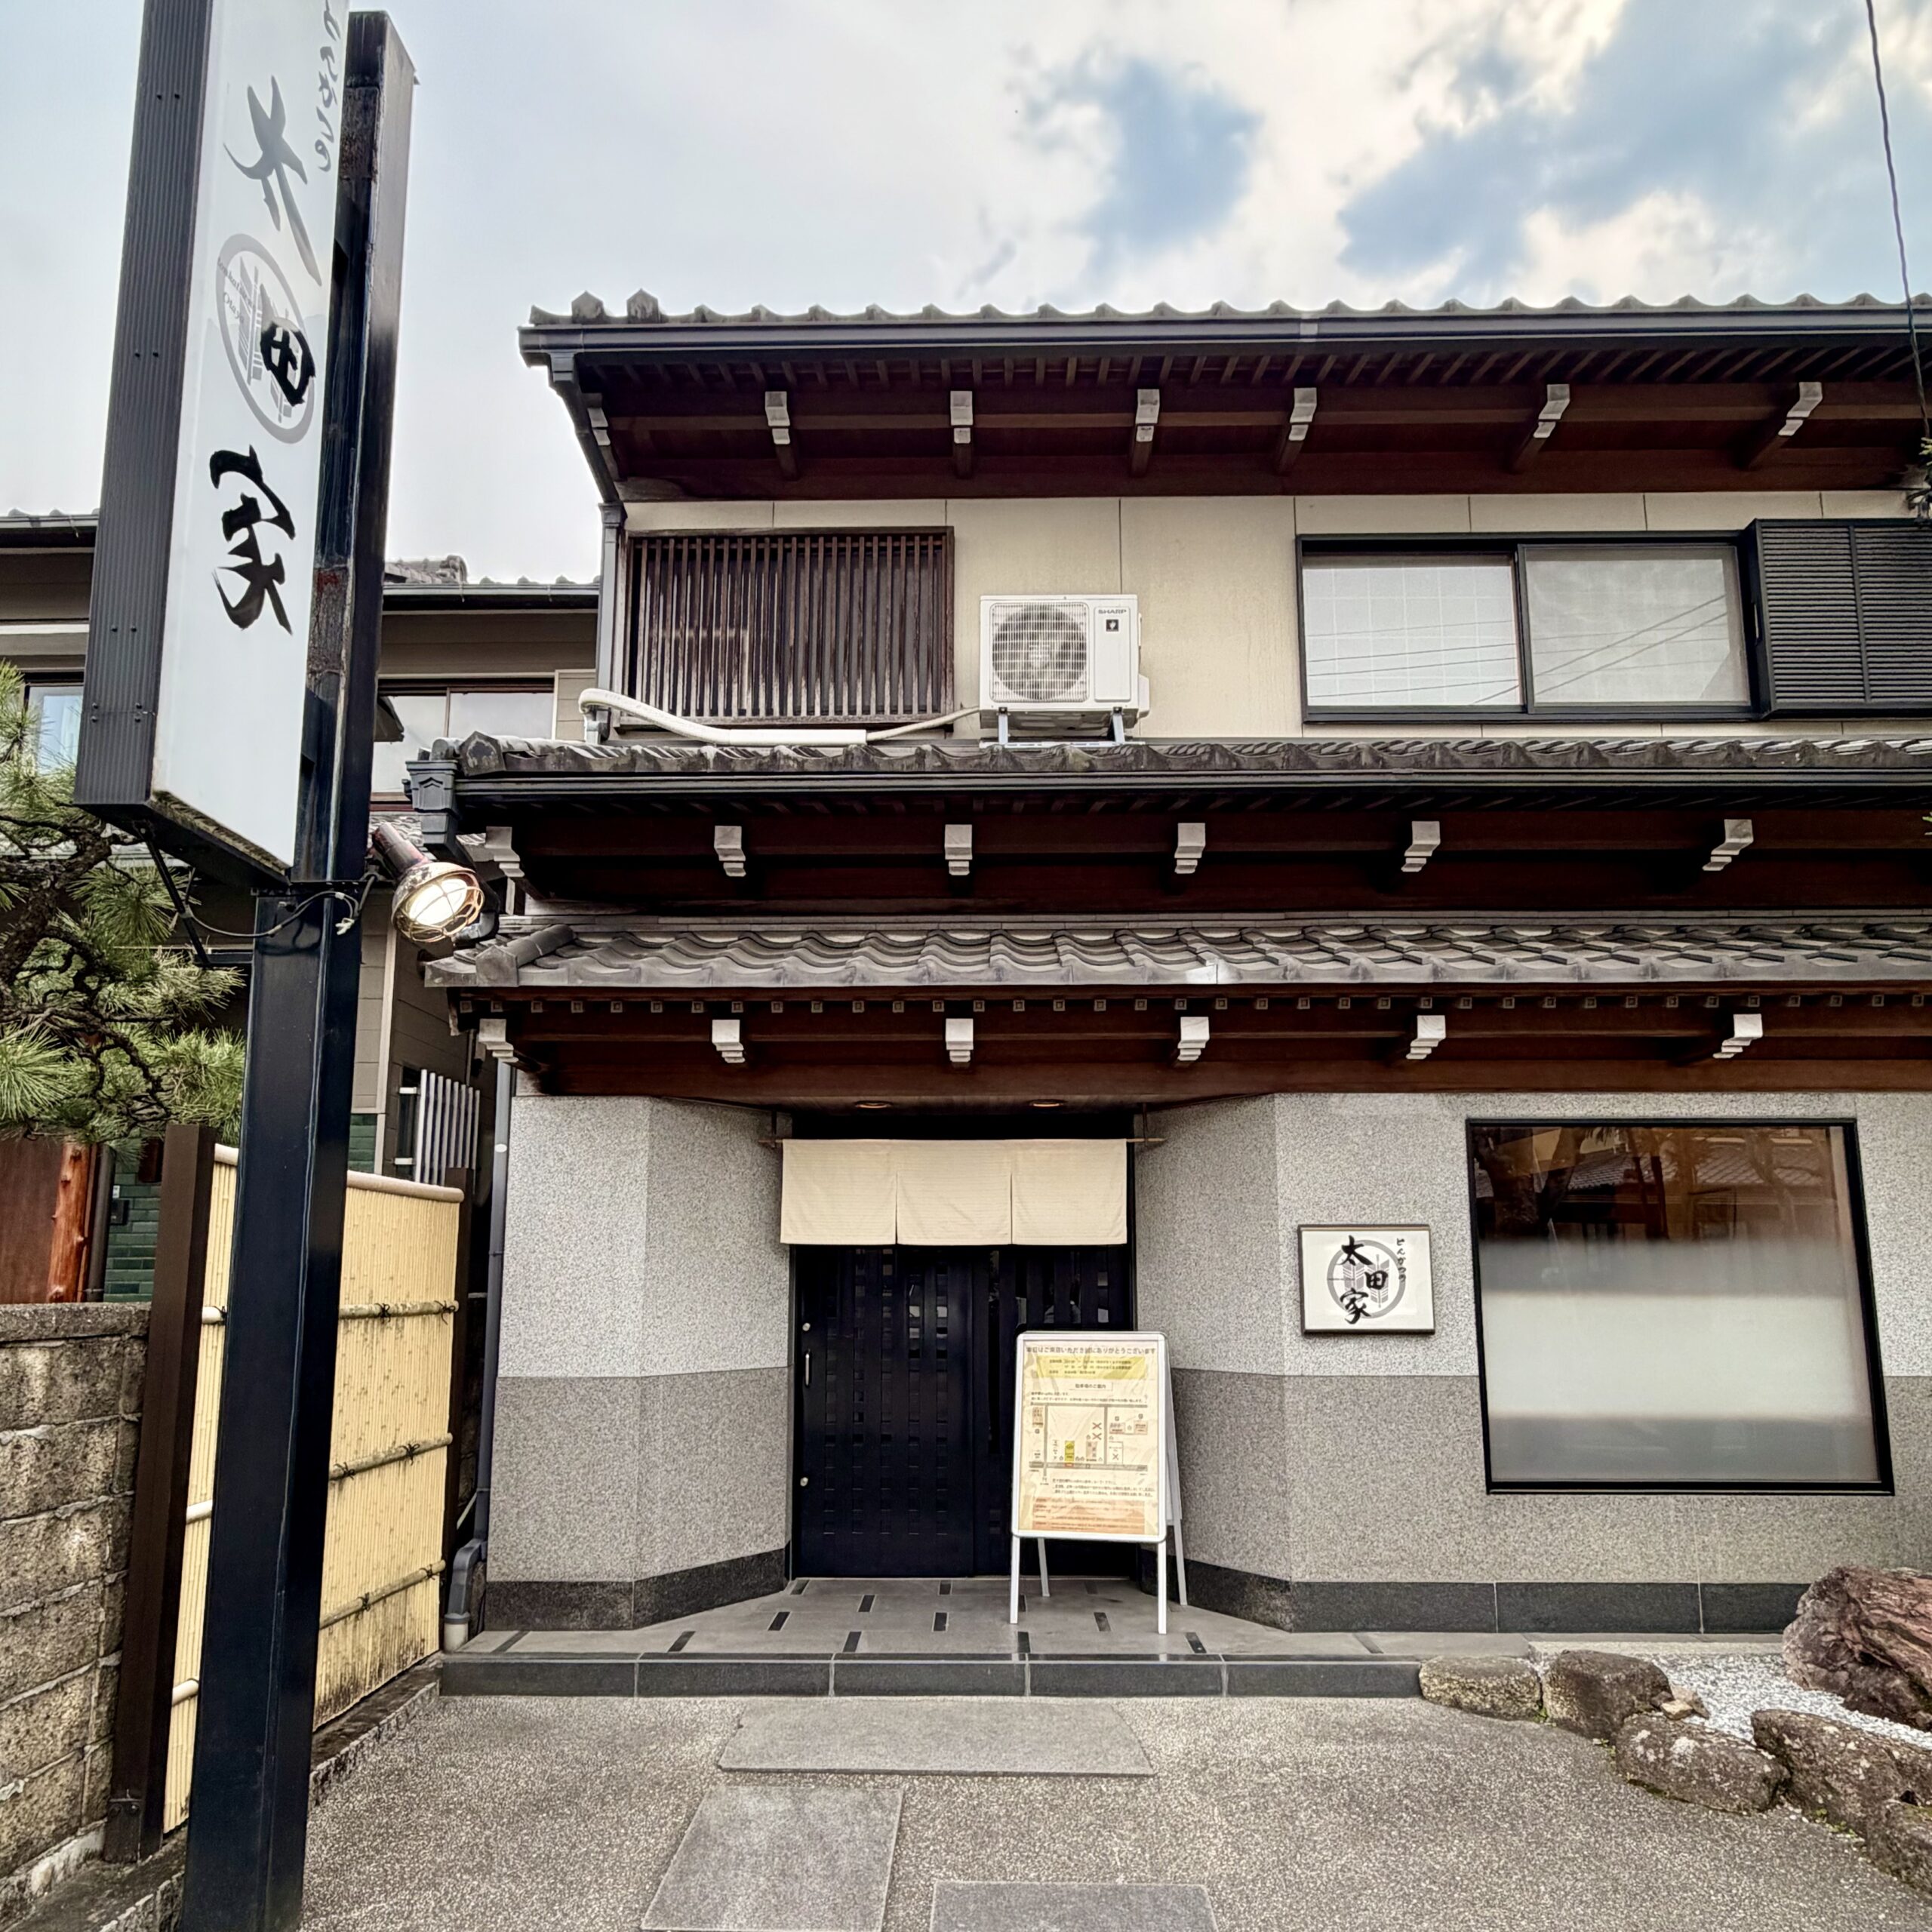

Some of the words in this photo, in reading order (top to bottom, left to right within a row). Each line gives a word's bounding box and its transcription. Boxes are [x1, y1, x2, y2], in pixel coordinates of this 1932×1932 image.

[209, 74, 322, 635] 太田家
[1336, 1235, 1388, 1324] 太田家
